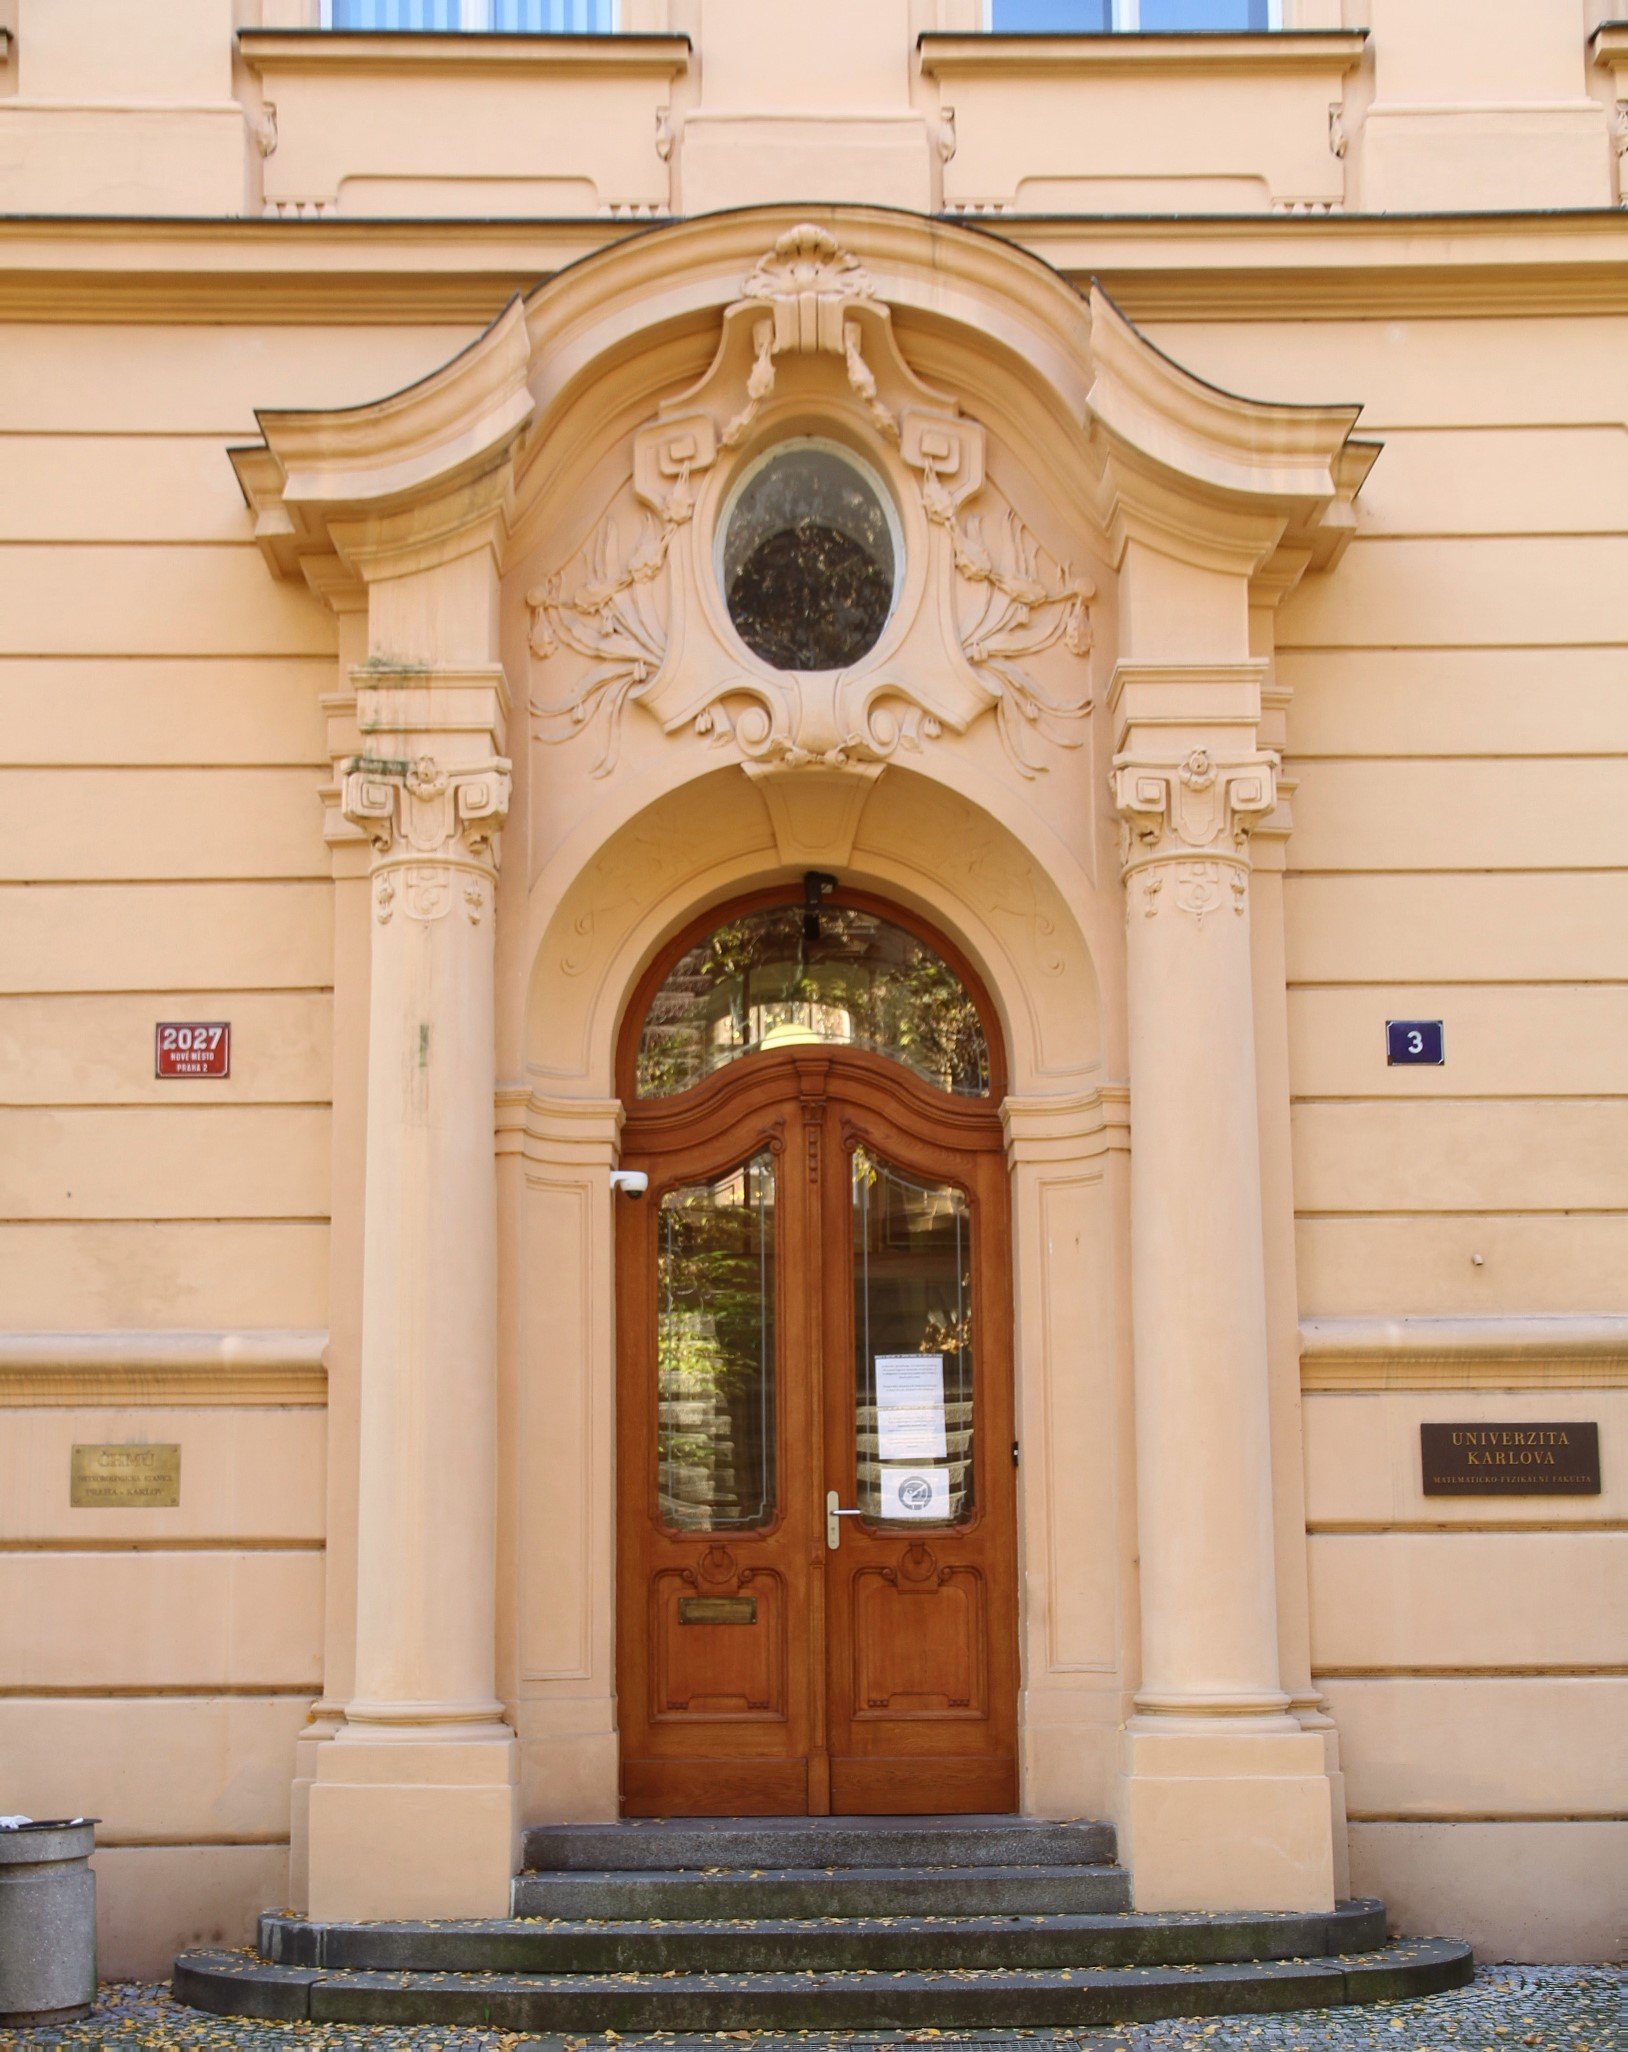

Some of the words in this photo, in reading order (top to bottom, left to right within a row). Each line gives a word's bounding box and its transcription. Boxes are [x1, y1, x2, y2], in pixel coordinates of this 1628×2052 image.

[163, 1028, 223, 1050] 2027
[1407, 1030, 1424, 1054] 3
[176, 1063, 201, 1072] PRAHA
[202, 1063, 208, 1072] 2
[1452, 1431, 1570, 1445] UNIVERZITA
[1467, 1451, 1556, 1465] KARLOVA
[1552, 1475, 1592, 1484] FAKULTA
